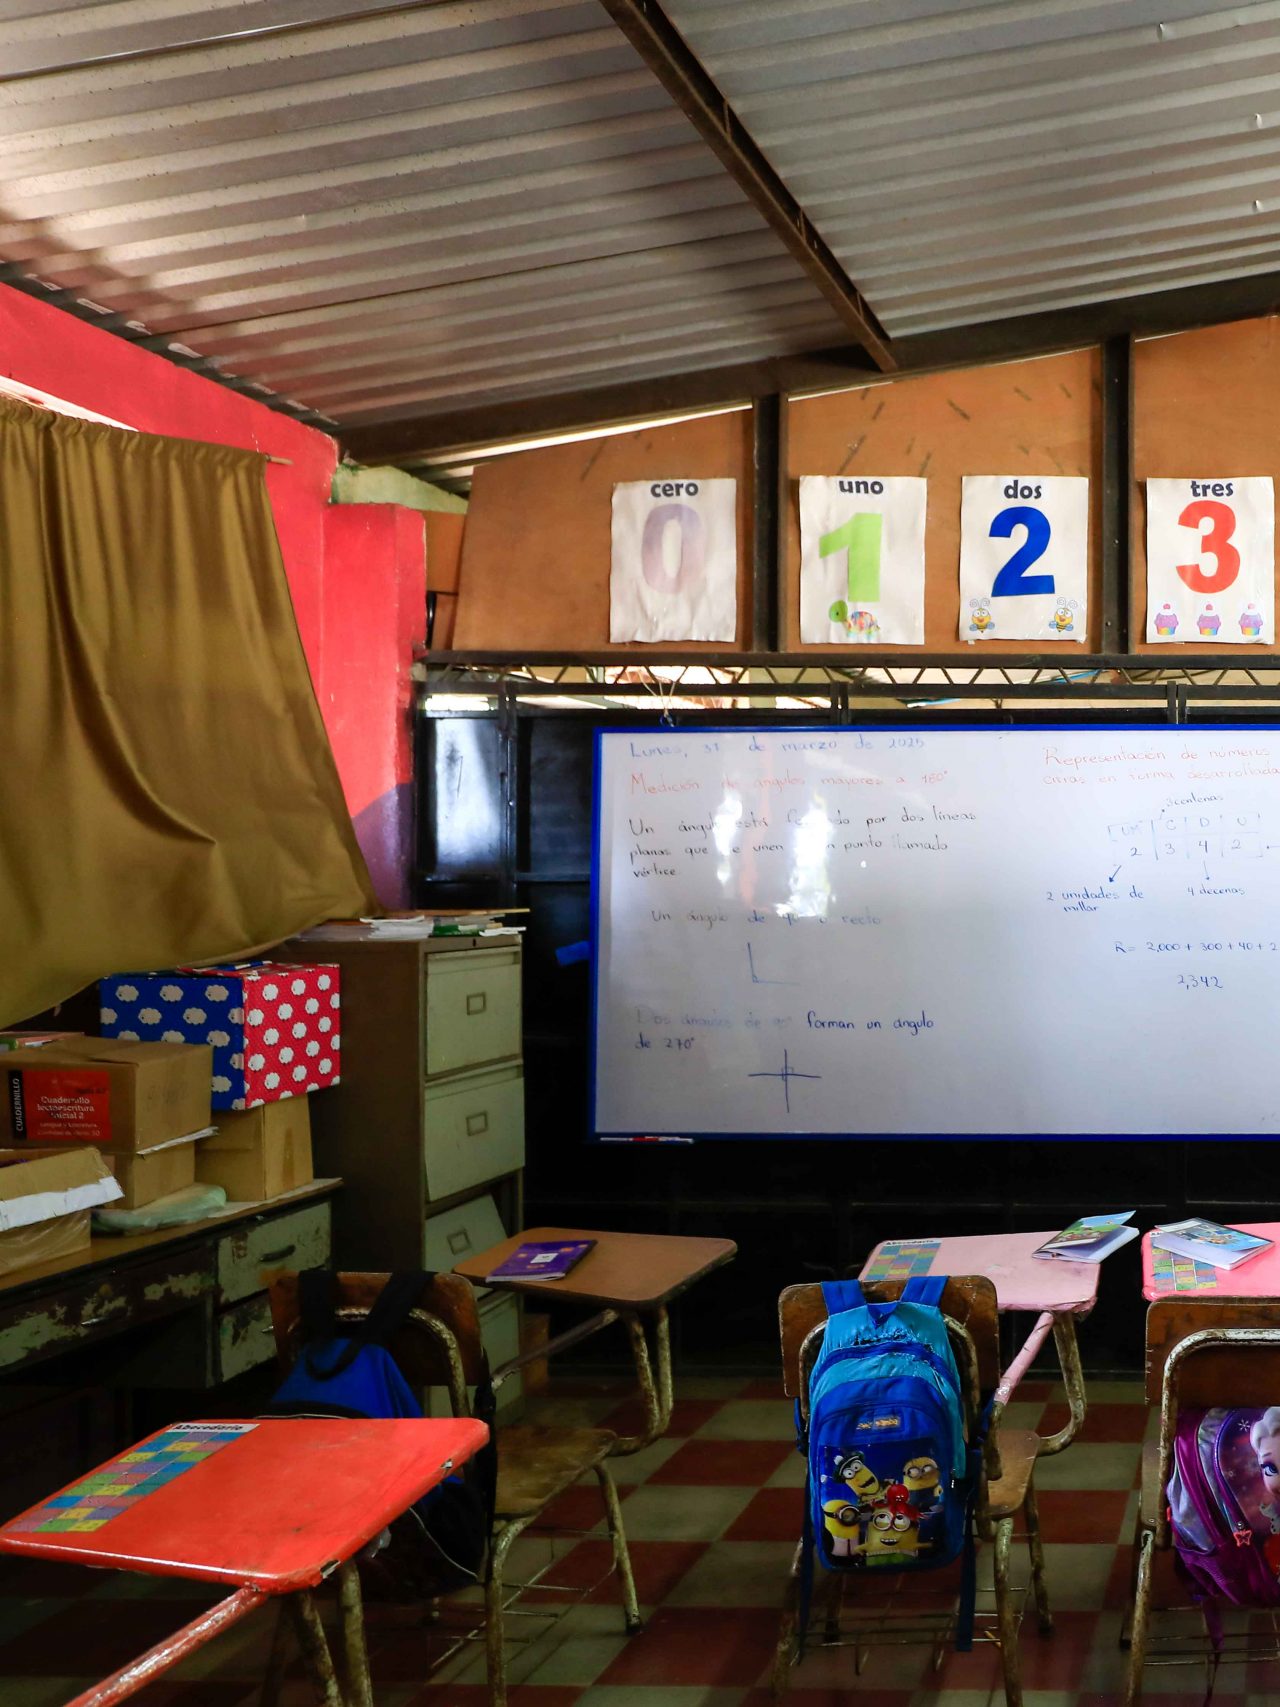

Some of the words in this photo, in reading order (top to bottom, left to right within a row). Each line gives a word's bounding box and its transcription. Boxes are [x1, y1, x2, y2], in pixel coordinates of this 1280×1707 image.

[651, 480, 698, 498] cero
[839, 479, 884, 495] uno
[1004, 479, 1043, 499] dos
[1191, 480, 1234, 498] tres
[642, 503, 704, 594] 0
[989, 506, 1056, 597] 2
[1175, 500, 1241, 594] 3
[819, 513, 882, 602] 1
[748, 736, 766, 752] de
[781, 739, 838, 752] marzo
[855, 733, 873, 749] de
[1181, 743, 1199, 760] de
[895, 776, 906, 784] a
[629, 817, 655, 837] Un
[678, 811, 718, 839] ángul
[865, 816, 887, 832] por
[900, 806, 926, 822] dos
[629, 842, 672, 865] planas
[684, 845, 709, 860] que
[752, 844, 785, 853] unen
[844, 834, 883, 852] punto
[1130, 846, 1143, 857] 2
[1165, 842, 1176, 855] 3
[1198, 839, 1209, 853] 4
[1231, 838, 1242, 850] 2
[1046, 891, 1055, 902] 2
[1061, 886, 1121, 901] unidades
[1129, 885, 1144, 900] de
[1200, 884, 1246, 896] decenas
[651, 909, 672, 923] Un
[747, 909, 765, 924] de
[841, 906, 881, 925] recto
[1063, 901, 1100, 913] millar
[1199, 941, 1223, 951] 300
[1176, 974, 1224, 990] 2,342
[807, 1009, 856, 1030] forman
[866, 1020, 882, 1030] un
[634, 1031, 652, 1049] de
[12, 1078, 24, 1132] CUADERNILLO
